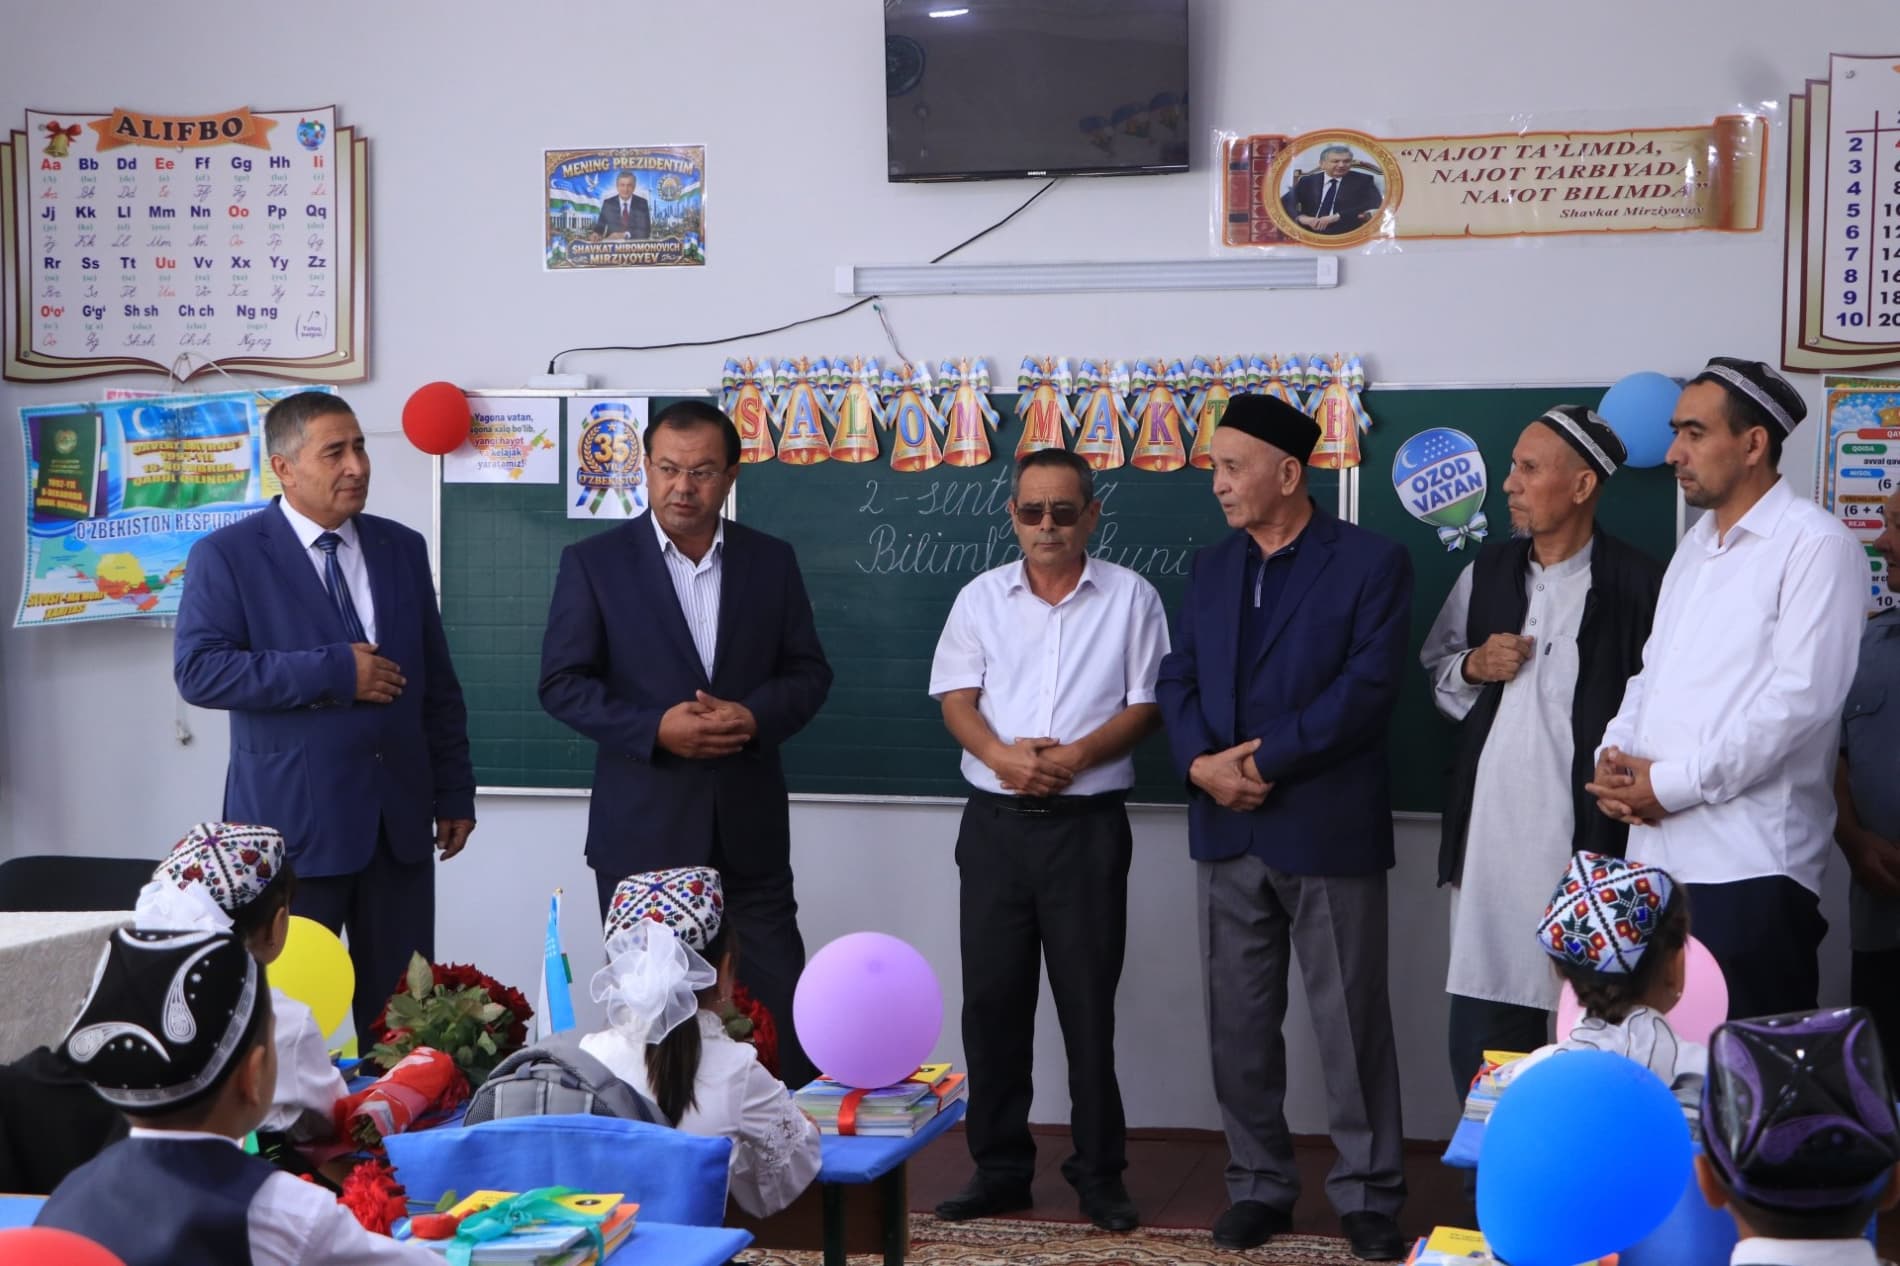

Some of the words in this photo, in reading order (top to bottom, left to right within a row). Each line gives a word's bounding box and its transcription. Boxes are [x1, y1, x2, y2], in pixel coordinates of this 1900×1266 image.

[115, 116, 244, 141] ALIFBO
[1848, 138, 1863, 152] 2
[1401, 147, 1509, 162] “NAJOT
[41, 158, 62, 170] Aa
[79, 158, 98, 170] Bb
[117, 158, 136, 170] Dd
[155, 158, 174, 170] Ee
[195, 157, 210, 169] Ff
[232, 157, 252, 172] Gg
[270, 156, 290, 168] Hh
[313, 155, 324, 168] Ii
[562, 159, 610, 177] MENING
[613, 157, 694, 175] PREZIDENTIM
[1848, 160, 1862, 173] 3
[1431, 167, 1525, 184] NAJOT
[1535, 161, 1702, 179] TARBIYADA,
[1461, 187, 1556, 204] NAJOT
[1847, 182, 1861, 195] 4
[42, 206, 54, 221] Jj
[76, 206, 96, 218] Kk
[118, 206, 130, 218] Ll
[149, 206, 176, 218] Mm
[190, 206, 210, 217] Nn
[228, 205, 249, 217] Oo
[268, 205, 286, 220] Pp
[306, 204, 326, 219] Qq
[1559, 207, 1619, 219] Shavkat
[1847, 204, 1860, 217] 5
[1846, 225, 1859, 239] 6
[572, 245, 613, 254] SHAVKAT
[1845, 247, 1858, 261] 7
[44, 257, 61, 269] Rr
[82, 257, 100, 269] Ss
[120, 257, 136, 268] Tt
[156, 257, 176, 269] Uu
[194, 256, 213, 268] Vv
[231, 256, 251, 268] Xx
[270, 256, 288, 271] Yy
[308, 256, 326, 268] Zz
[590, 253, 659, 264] MIRZIYOYEV
[1844, 269, 1858, 283] 8
[1844, 290, 1857, 305] 9
[124, 305, 140, 317] Sh
[144, 305, 158, 317] sh
[178, 305, 195, 317] Ch
[199, 305, 214, 317] ch
[237, 305, 256, 320] Ng
[260, 307, 278, 320] ng
[1836, 312, 1863, 327] 10
[474, 413, 505, 424] Yagona
[507, 413, 534, 422] vatan,
[594, 432, 630, 463] 35
[1412, 457, 1470, 493] OZOD
[1878, 478, 1892, 491] (6
[1412, 472, 1482, 513] VATAN
[1844, 504, 1858, 517] (6
[1863, 506, 1871, 514] +
[1876, 596, 1893, 606] 10
